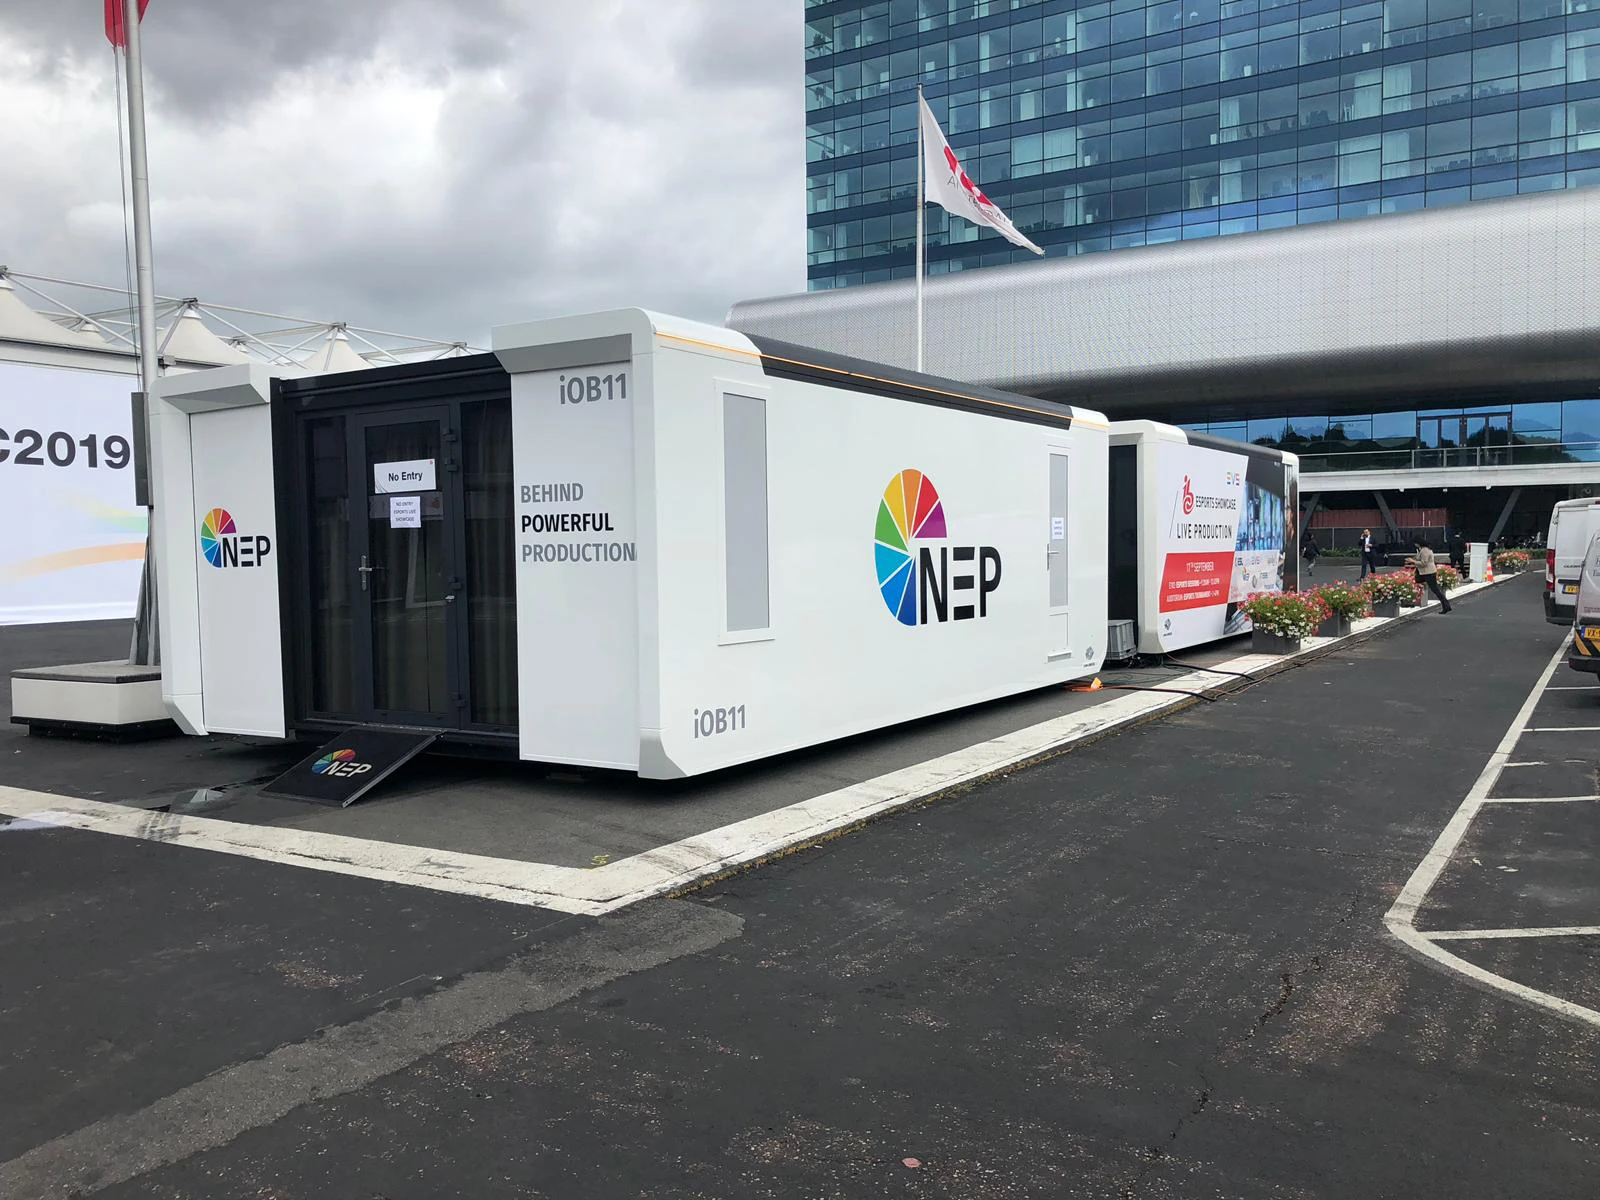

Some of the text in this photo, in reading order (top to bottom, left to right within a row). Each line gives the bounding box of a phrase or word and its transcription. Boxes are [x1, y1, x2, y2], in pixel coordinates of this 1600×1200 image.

[559, 373, 627, 405] iOB11
[388, 471, 423, 482] No Entry
[520, 483, 584, 503] BEHIND
[1195, 495, 1237, 511] ESPORTS SHOWCASE
[521, 512, 614, 533] POWERFUL
[1177, 522, 1233, 539] LIVE PRODUCTION
[222, 535, 272, 568] NEP
[522, 542, 638, 562] PRODUCTION
[919, 546, 1002, 625] NEP
[693, 704, 746, 739] iOB11
[320, 760, 372, 778] NEP
